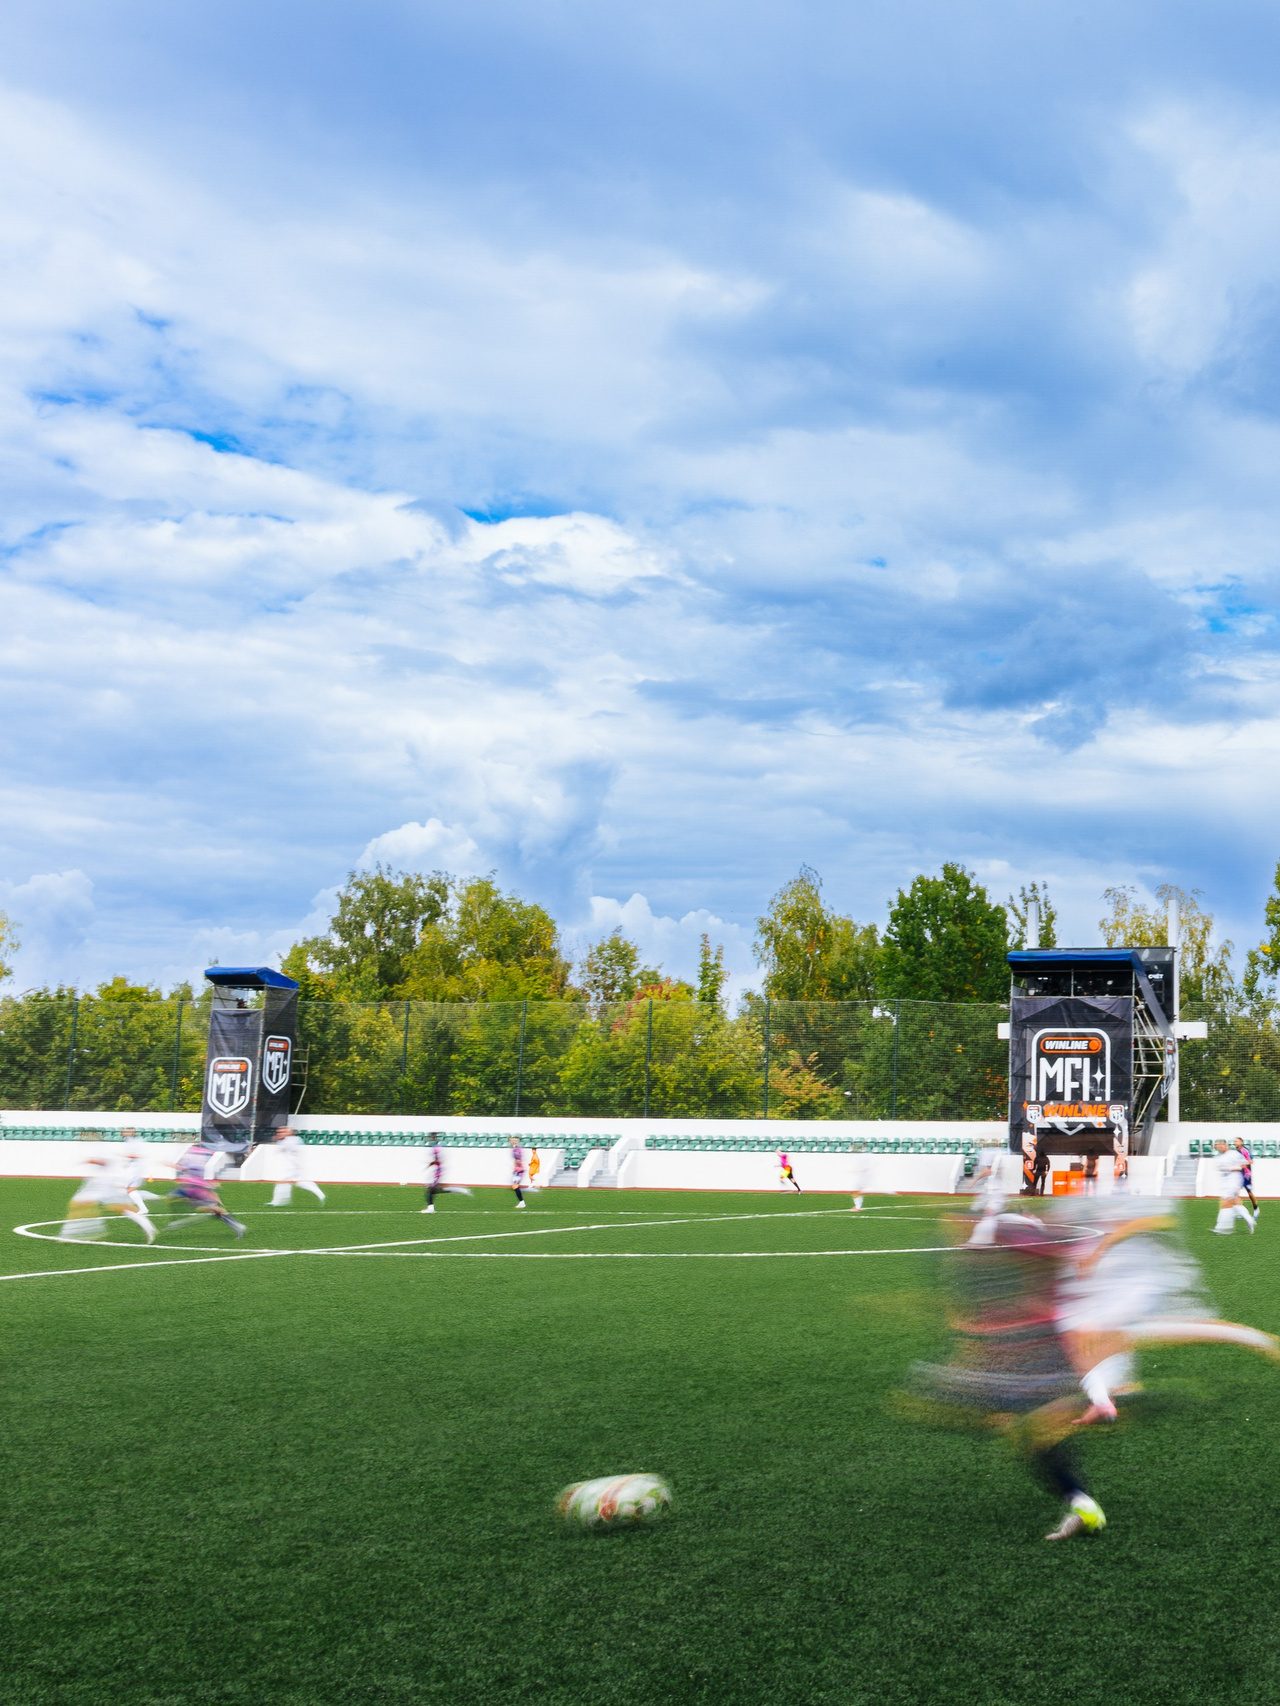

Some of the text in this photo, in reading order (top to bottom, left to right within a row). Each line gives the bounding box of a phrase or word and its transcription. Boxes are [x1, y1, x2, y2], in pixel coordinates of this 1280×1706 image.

[1045, 1040, 1089, 1050] WINLINE
[266, 1050, 286, 1089] MFL
[211, 1073, 246, 1113] MFL
[1043, 1104, 1107, 1117] WINLINE
